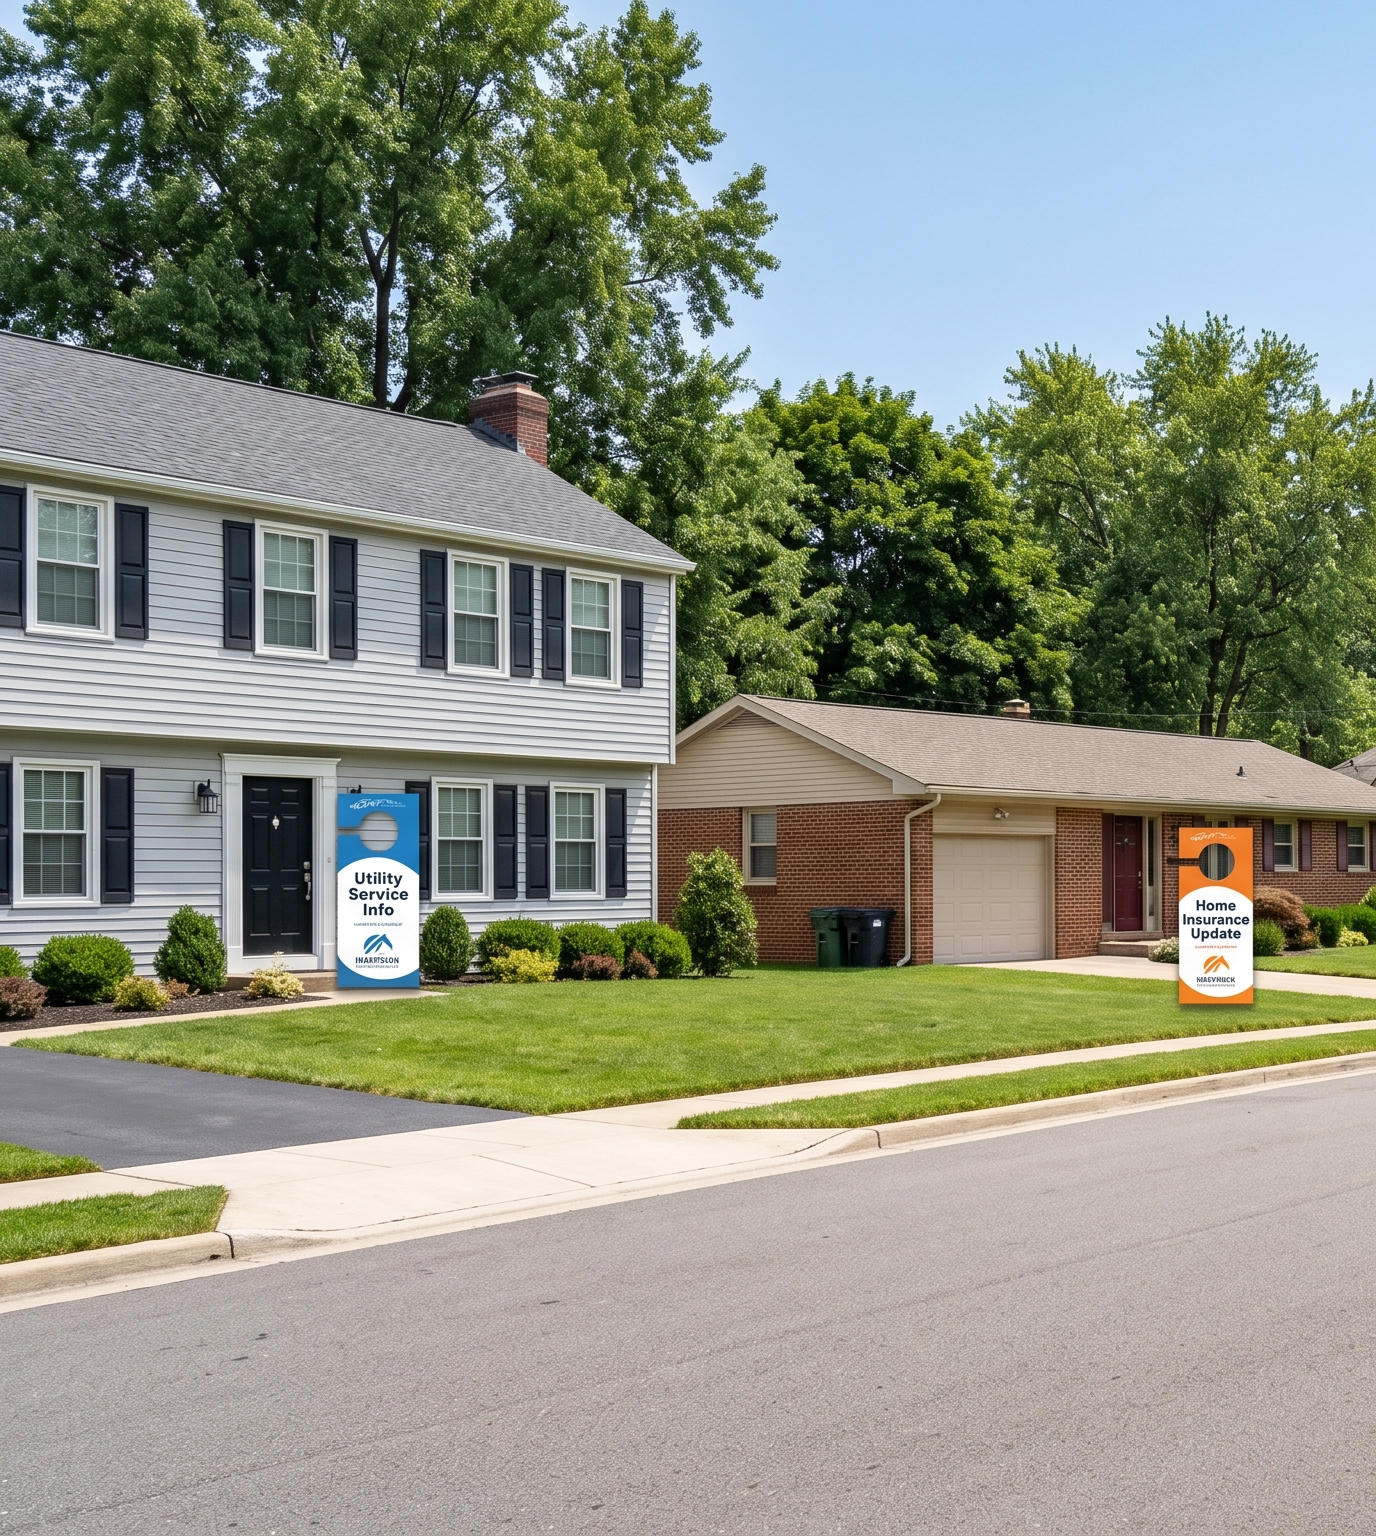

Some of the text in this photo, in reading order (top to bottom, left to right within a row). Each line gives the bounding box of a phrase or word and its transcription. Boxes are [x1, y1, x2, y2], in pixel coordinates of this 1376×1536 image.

[355, 872, 402, 888] Utility
[349, 888, 408, 900] Service
[363, 903, 394, 916] Info
[1196, 900, 1236, 911] Home
[1183, 914, 1249, 925] Insurance
[1191, 927, 1241, 942] Update
